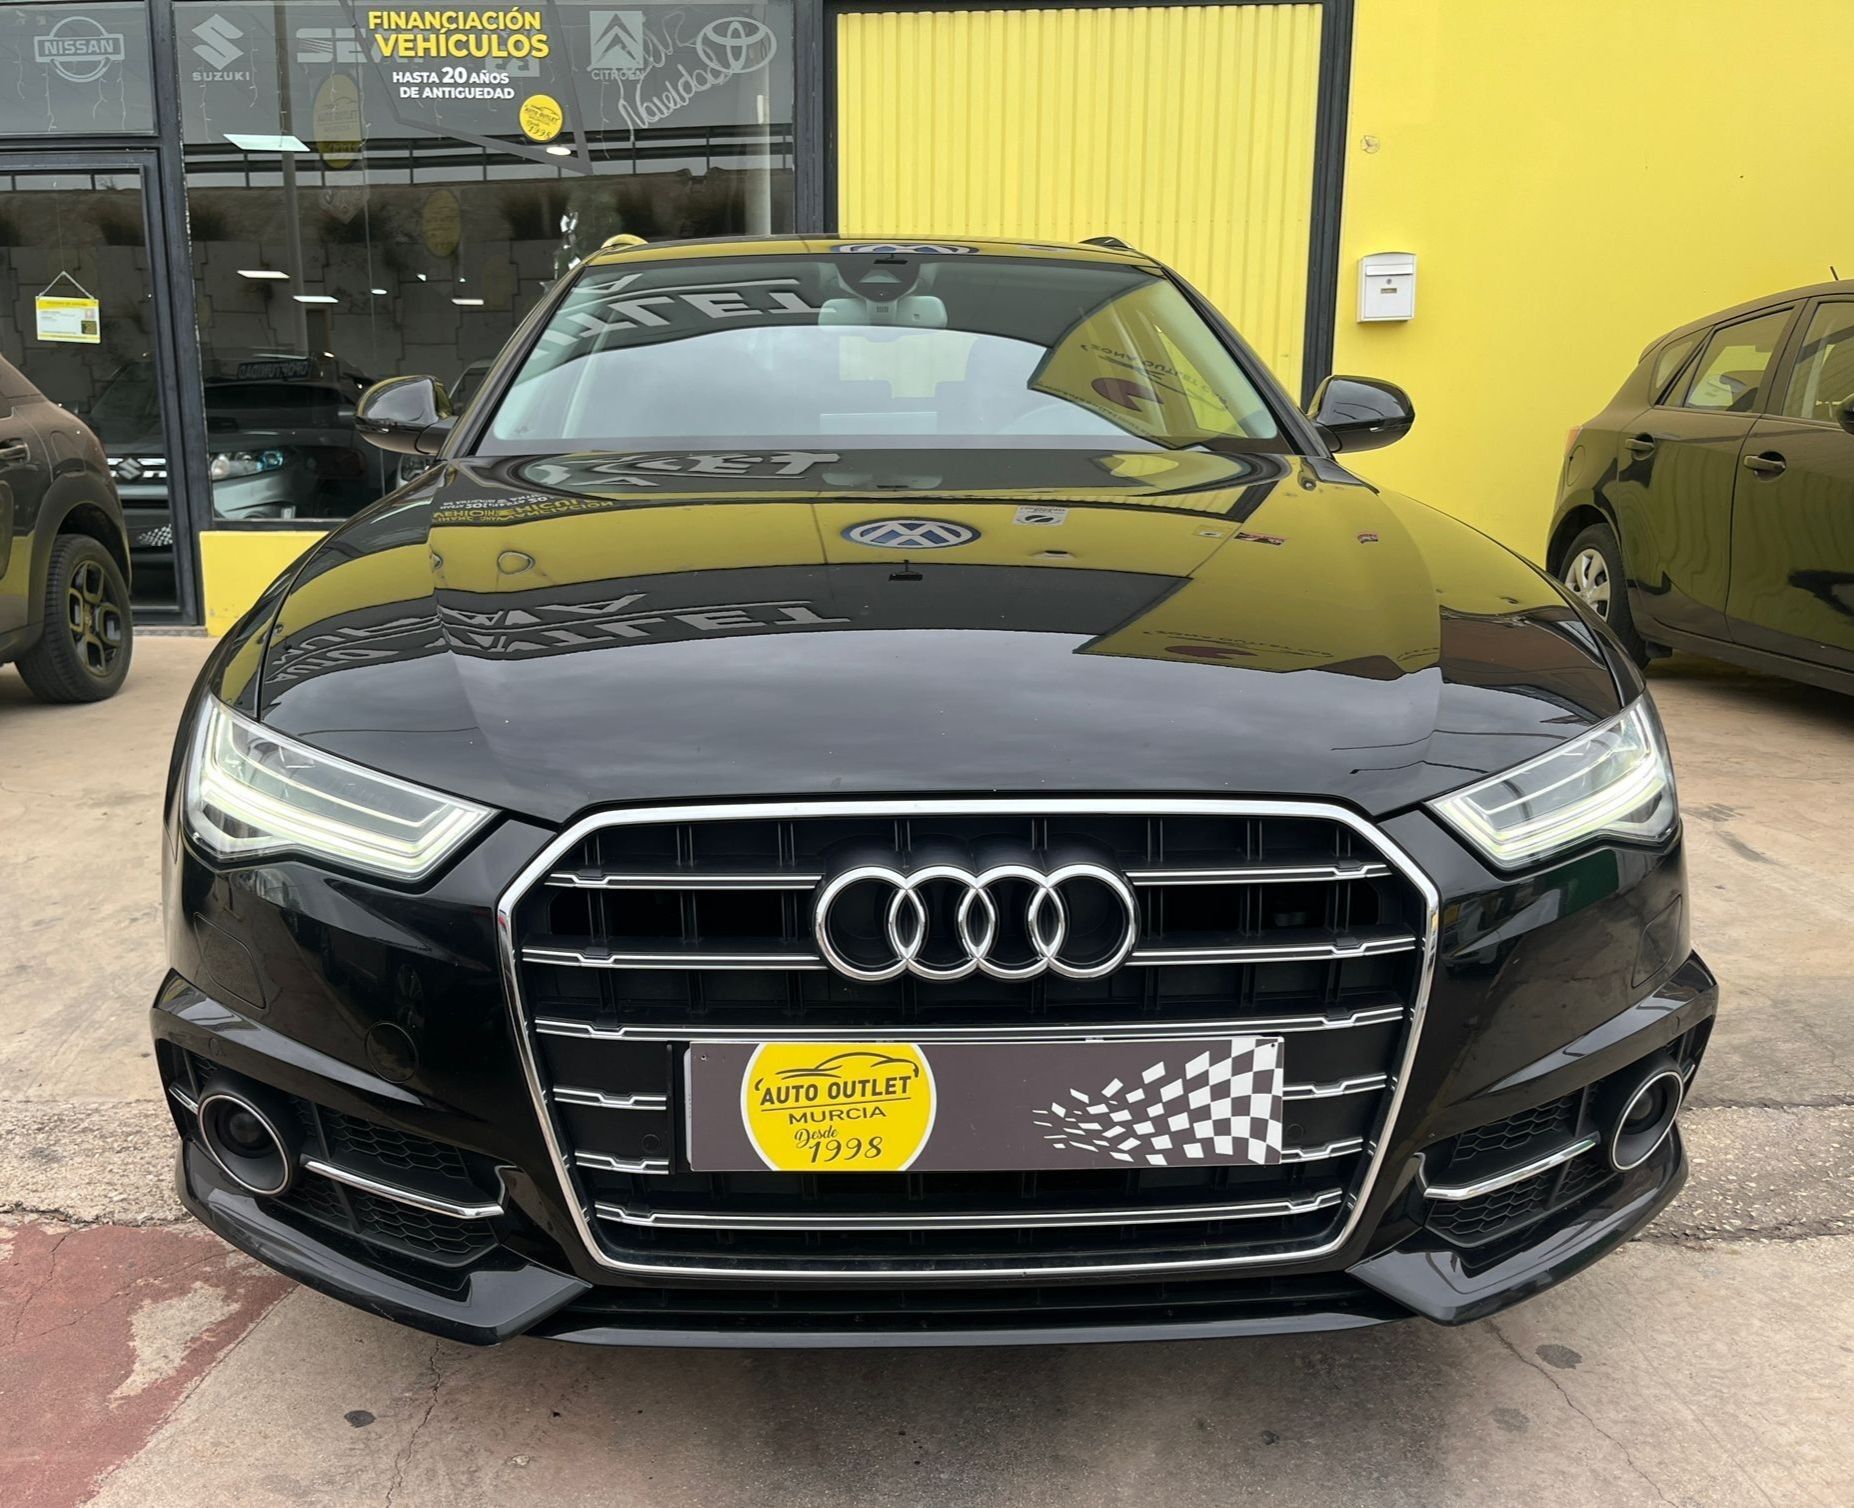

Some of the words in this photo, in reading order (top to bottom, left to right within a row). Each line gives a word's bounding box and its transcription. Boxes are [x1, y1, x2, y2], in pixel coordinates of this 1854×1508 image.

[368, 7, 541, 31] FINANCIACIÓN
[44, 39, 114, 55] NISSAN
[374, 28, 550, 58] VEHÍCULOS
[192, 71, 250, 81] SUZUKI
[392, 71, 440, 84] HASTA
[442, 66, 467, 84] 20
[469, 69, 510, 84] AÑOS
[400, 86, 419, 99] DE
[422, 86, 515, 99] ANTIGUEDAD
[760, 1083, 819, 1106] AUTO
[827, 1075, 911, 1100] OUTLET
[789, 1106, 886, 1125] MURCIA
[794, 1125, 838, 1149] Desde
[809, 1136, 883, 1164] 1998
